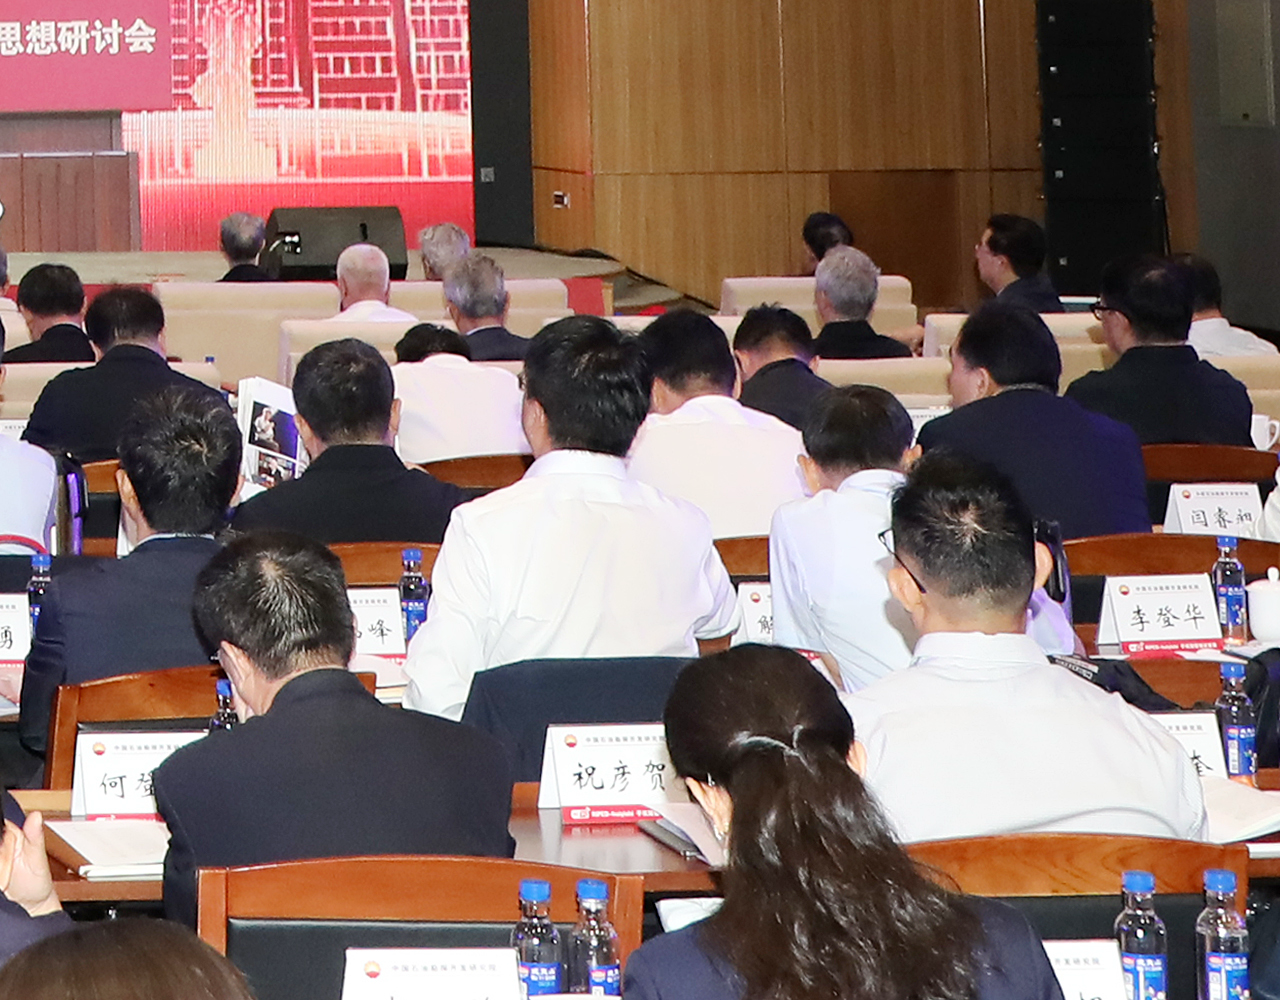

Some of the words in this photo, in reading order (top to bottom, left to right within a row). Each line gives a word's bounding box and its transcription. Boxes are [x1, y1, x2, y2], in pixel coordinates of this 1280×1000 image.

[1130, 603, 1206, 632] 李登华
[572, 759, 666, 792] 祝彦贺
